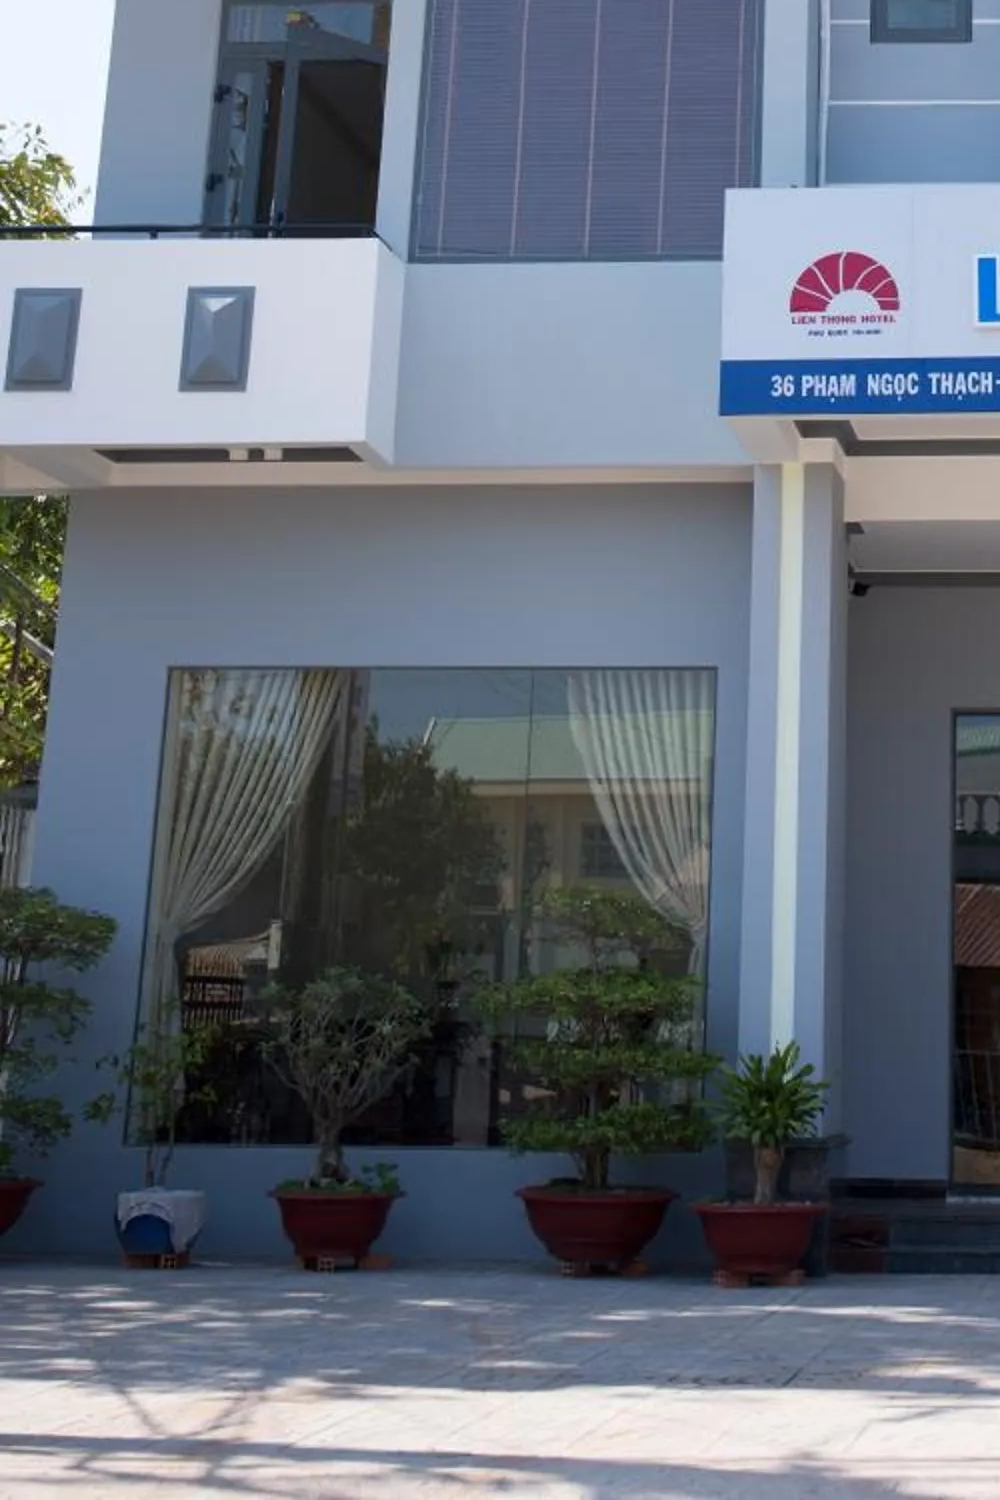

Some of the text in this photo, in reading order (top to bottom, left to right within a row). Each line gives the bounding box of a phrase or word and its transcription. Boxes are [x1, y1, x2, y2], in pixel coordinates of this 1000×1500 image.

[771, 375, 795, 397] 36
[801, 374, 856, 402] PHẠM
[867, 373, 919, 401] NGỌC
